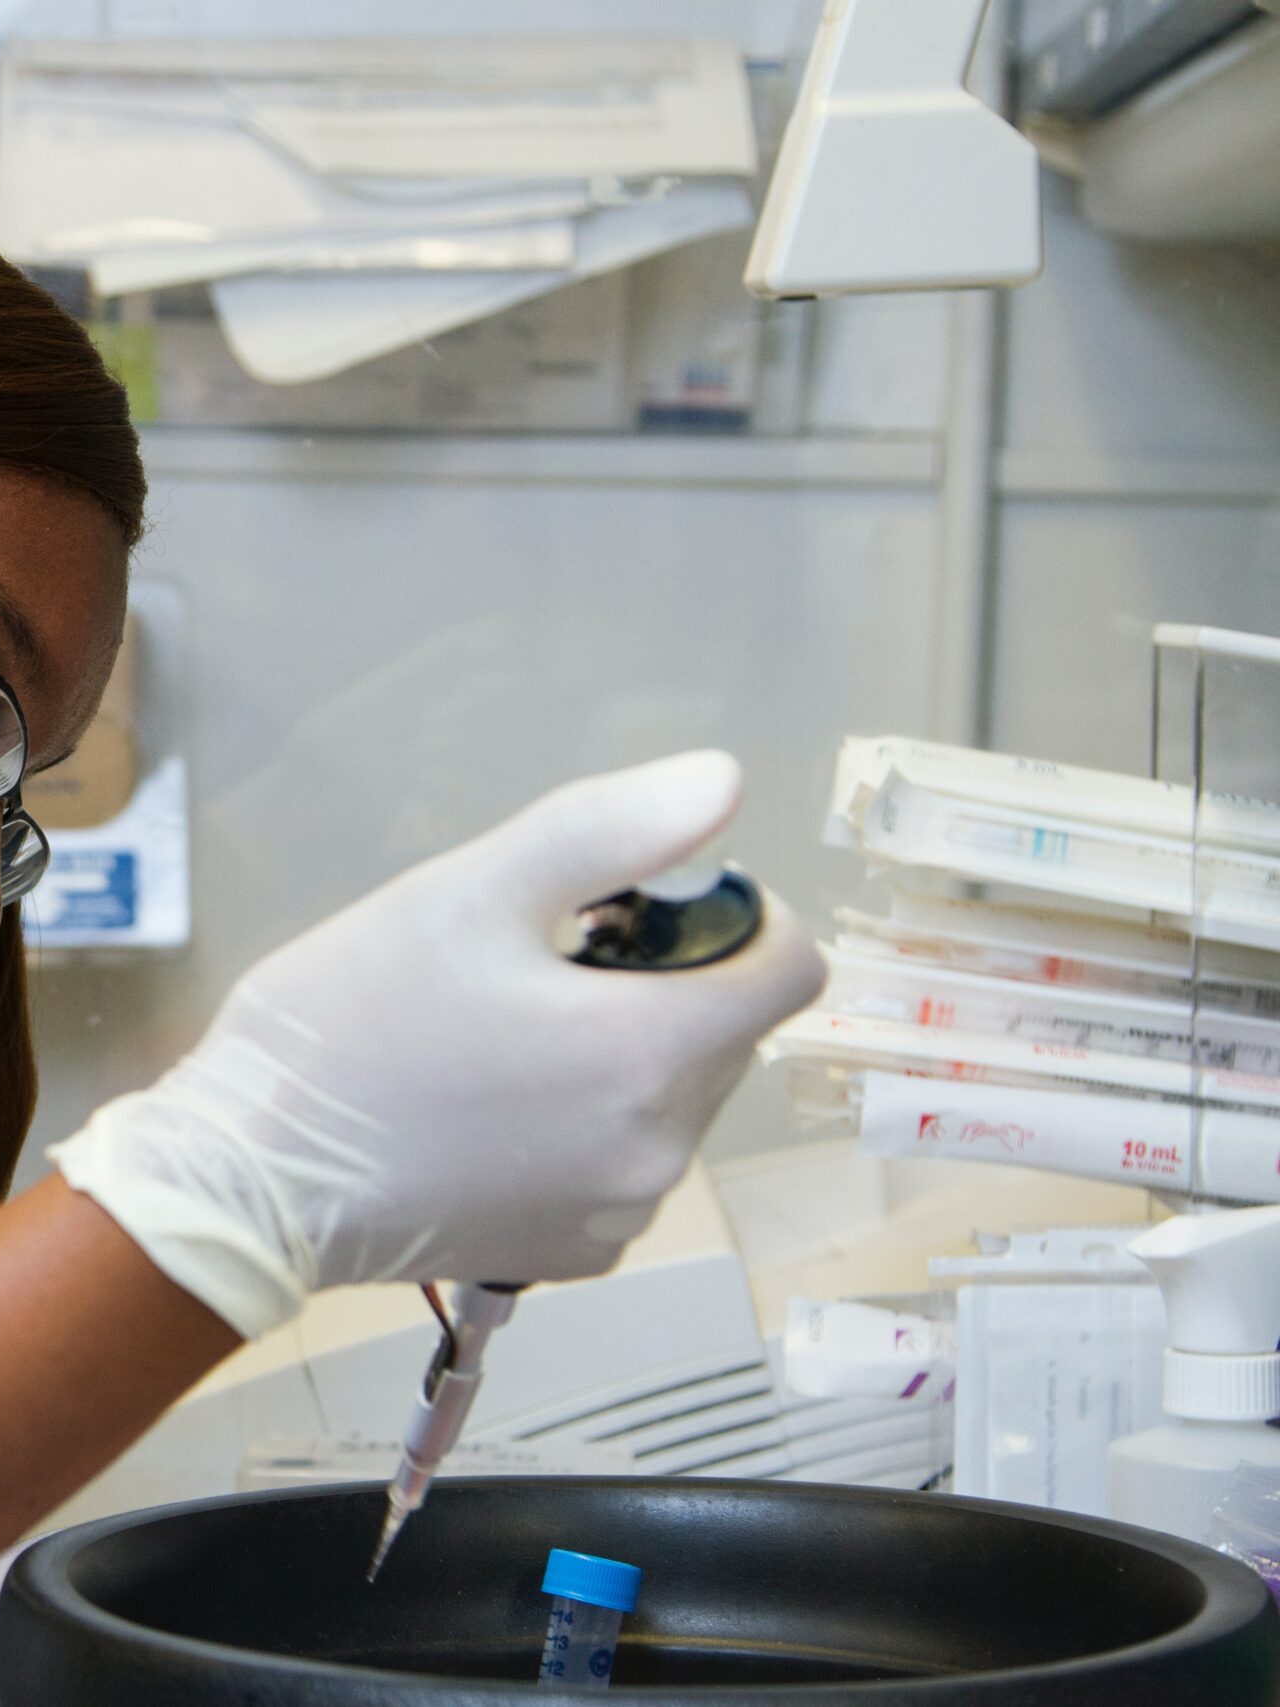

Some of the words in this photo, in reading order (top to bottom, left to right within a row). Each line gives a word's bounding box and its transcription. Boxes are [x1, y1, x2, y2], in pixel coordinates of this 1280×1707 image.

[1123, 1139, 1147, 1157] 10
[1151, 1144, 1183, 1164] mL
[556, 1609, 574, 1625] 14
[552, 1635, 570, 1651] 13
[547, 1660, 565, 1677] 12
